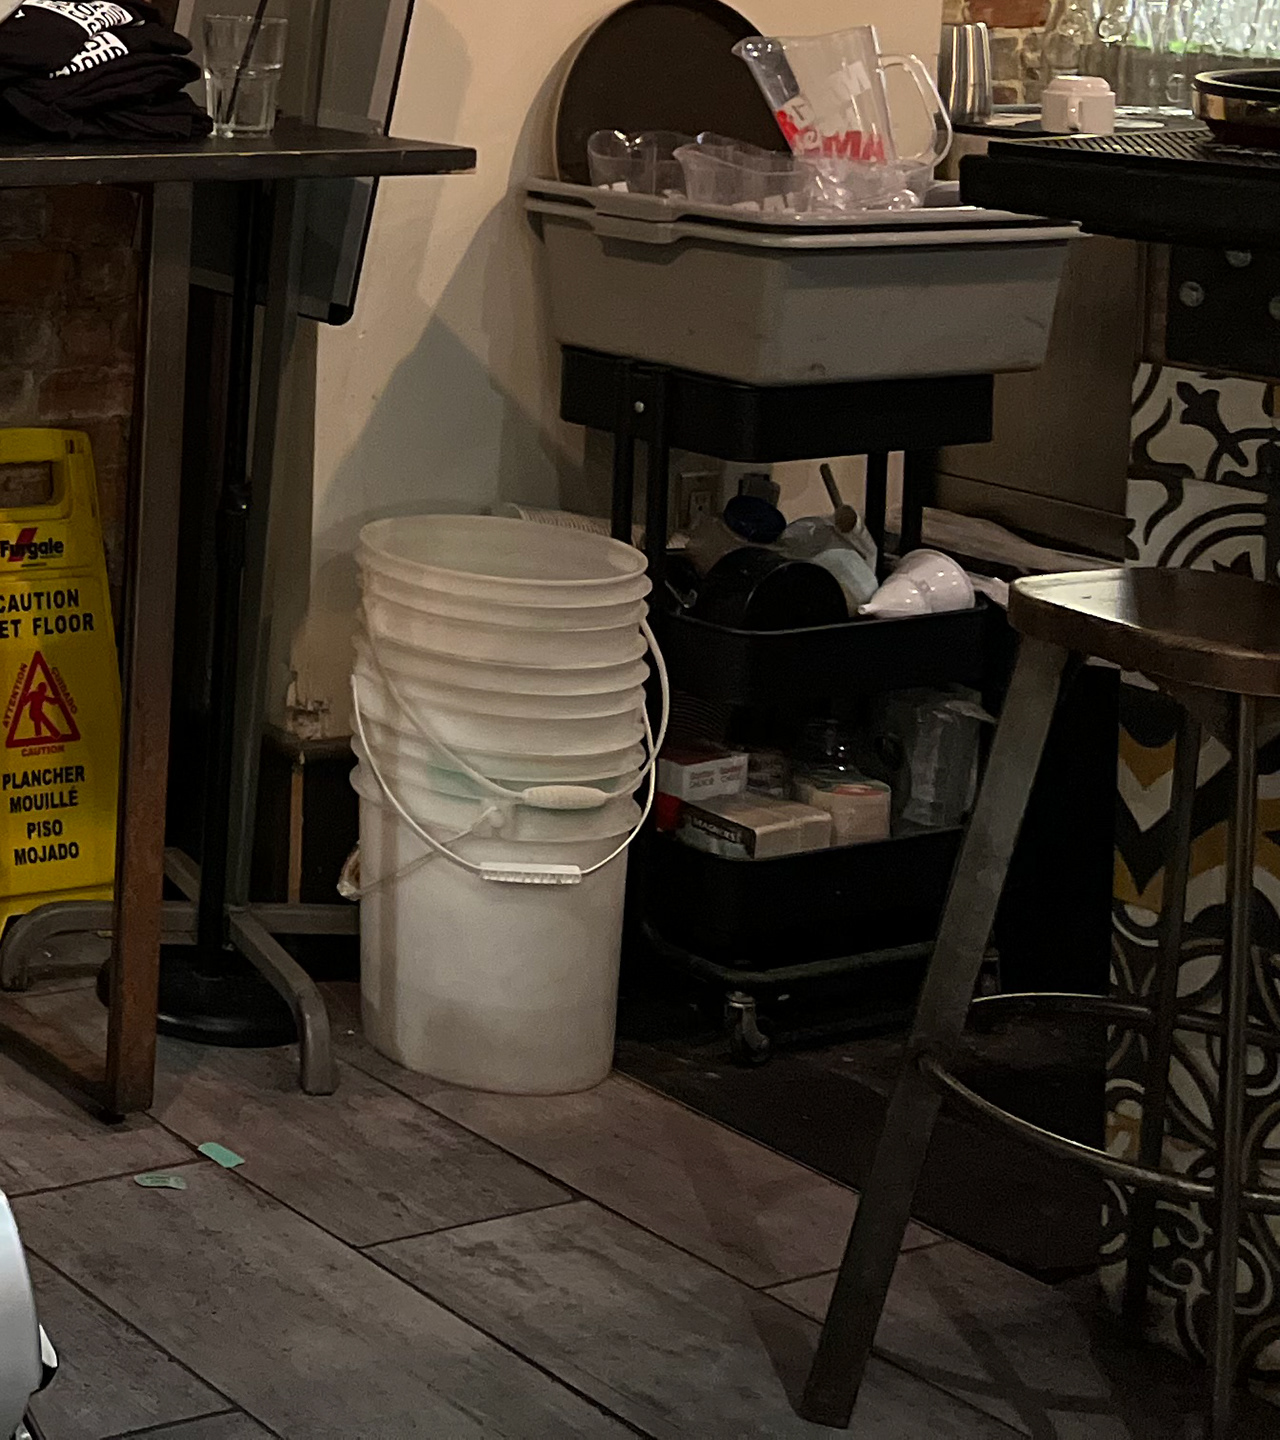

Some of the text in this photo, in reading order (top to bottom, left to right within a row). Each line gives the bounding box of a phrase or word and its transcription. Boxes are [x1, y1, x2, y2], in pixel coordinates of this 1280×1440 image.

[0, 537, 65, 560] Furgale
[32, 613, 94, 636] FLOOR
[2, 662, 28, 728] ATTENTION
[51, 666, 78, 715] CUIDADO
[21, 744, 66, 757] CAUTION
[2, 765, 85, 790] PLANCHER
[9, 786, 79, 813] MOUILLÉ
[26, 819, 63, 840] PISO
[14, 842, 80, 866] MOJADO
